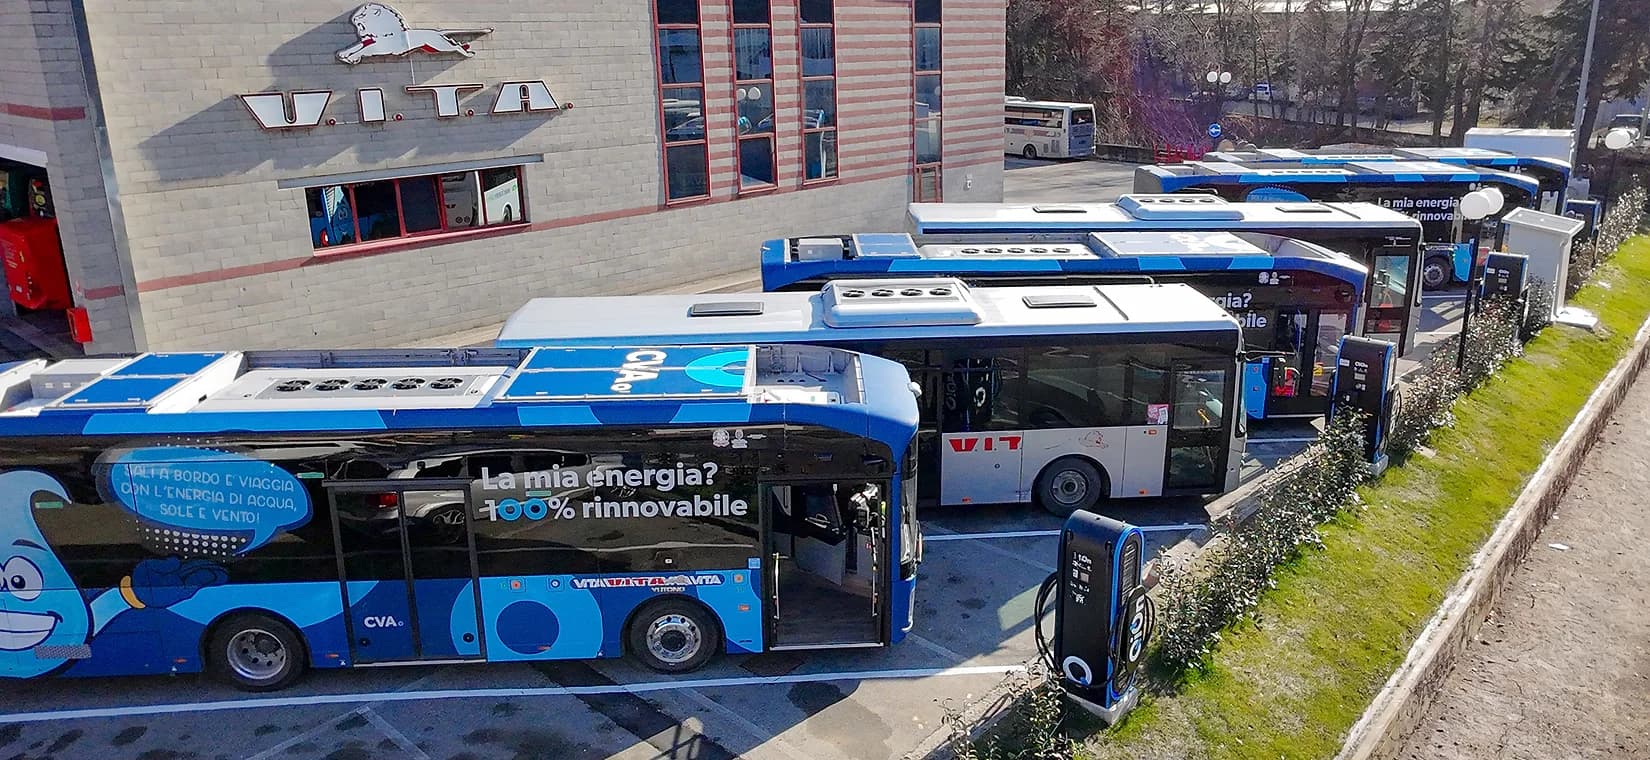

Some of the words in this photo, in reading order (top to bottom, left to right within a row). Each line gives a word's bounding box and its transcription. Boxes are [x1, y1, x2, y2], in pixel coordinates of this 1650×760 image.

[1393, 197, 1413, 208] mia
[1211, 292, 1252, 308] gia?
[1236, 311, 1267, 328] bile
[124, 464, 155, 479] SALI
[159, 469, 169, 479] A
[174, 470, 220, 485] BORDO
[239, 476, 295, 492] VIAGGIA
[481, 466, 516, 490] La
[524, 464, 579, 489] mia
[586, 462, 718, 492] energia?
[120, 482, 150, 496] CON
[154, 485, 225, 503] L'ENERGIA
[230, 493, 243, 504] DI
[247, 495, 297, 512] ACQUA,
[159, 503, 193, 518] SOLE
[199, 508, 206, 519] E
[212, 509, 260, 524] VENTO!
[480, 497, 576, 522] 100%
[583, 494, 748, 519] rinnovabile
[689, 575, 722, 585] VITA
[363, 616, 398, 628] CVA
